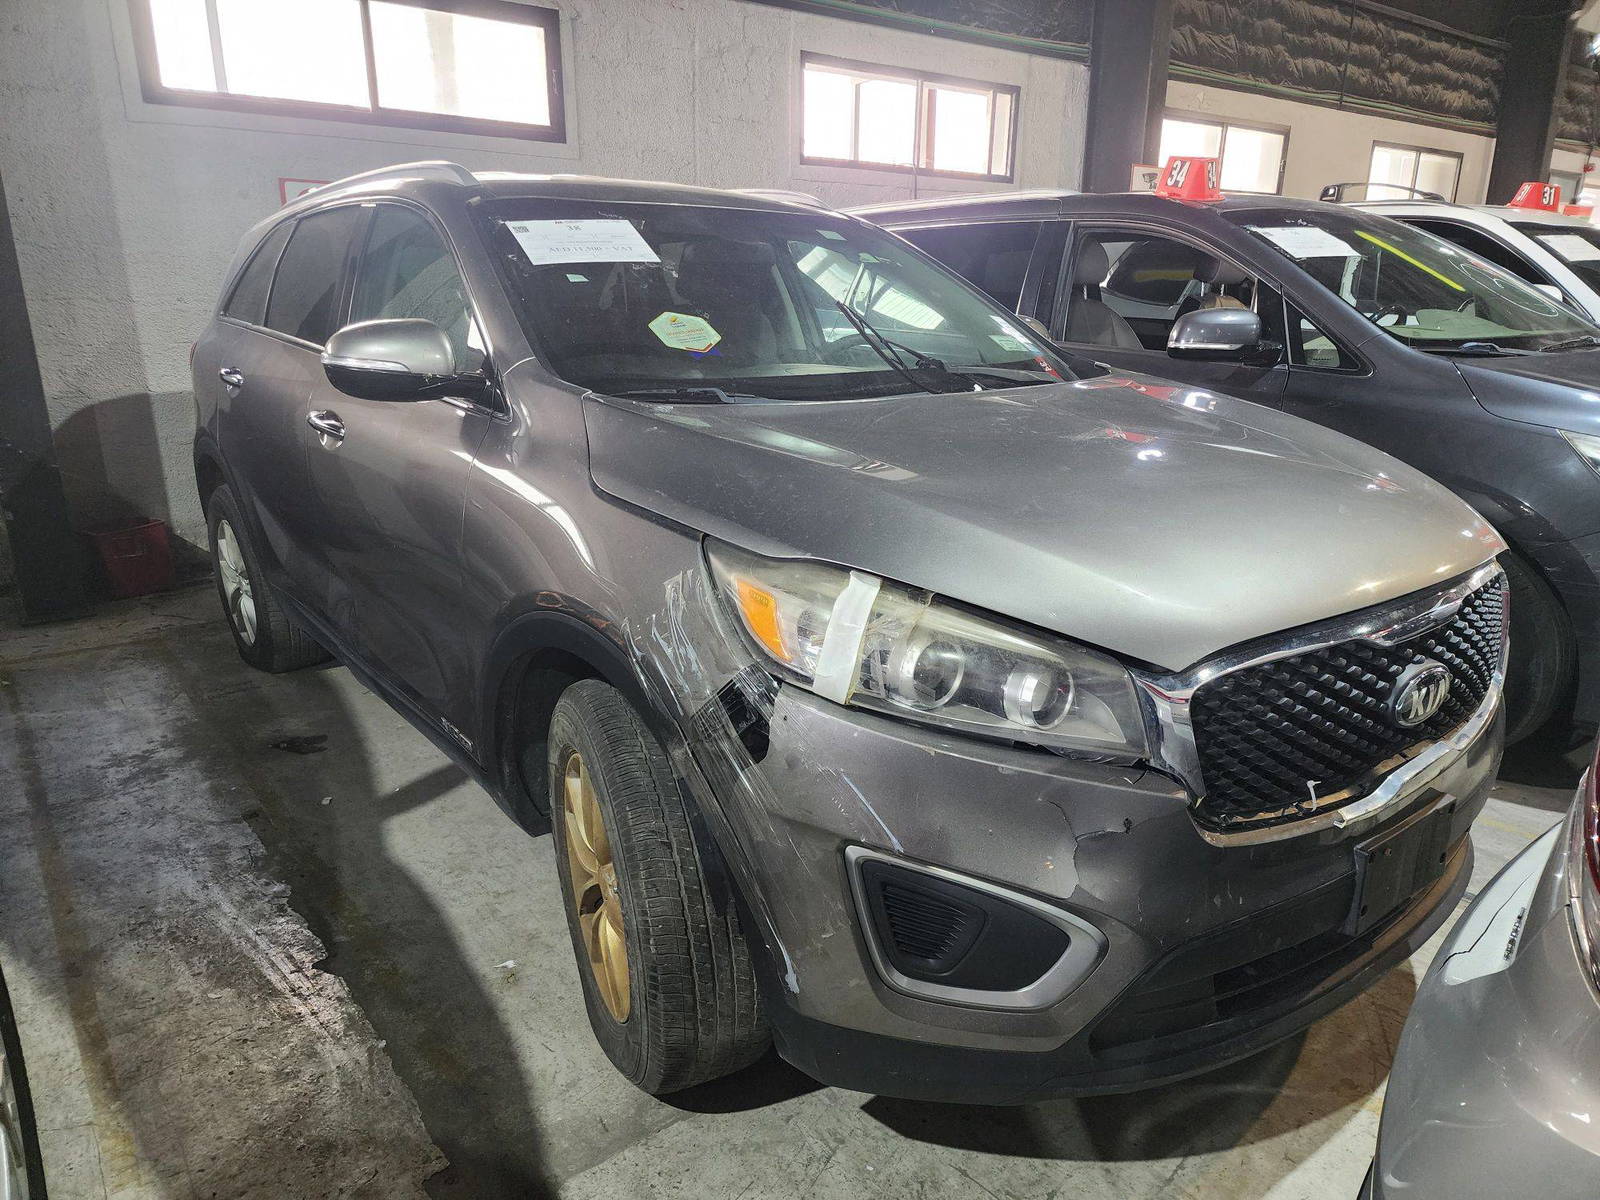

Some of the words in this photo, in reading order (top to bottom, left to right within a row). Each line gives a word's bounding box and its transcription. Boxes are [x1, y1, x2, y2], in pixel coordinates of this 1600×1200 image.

[1166, 159, 1191, 188] 34
[1207, 161, 1217, 189] 34
[1542, 186, 1556, 206] 31
[1408, 678, 1446, 719] KIA
